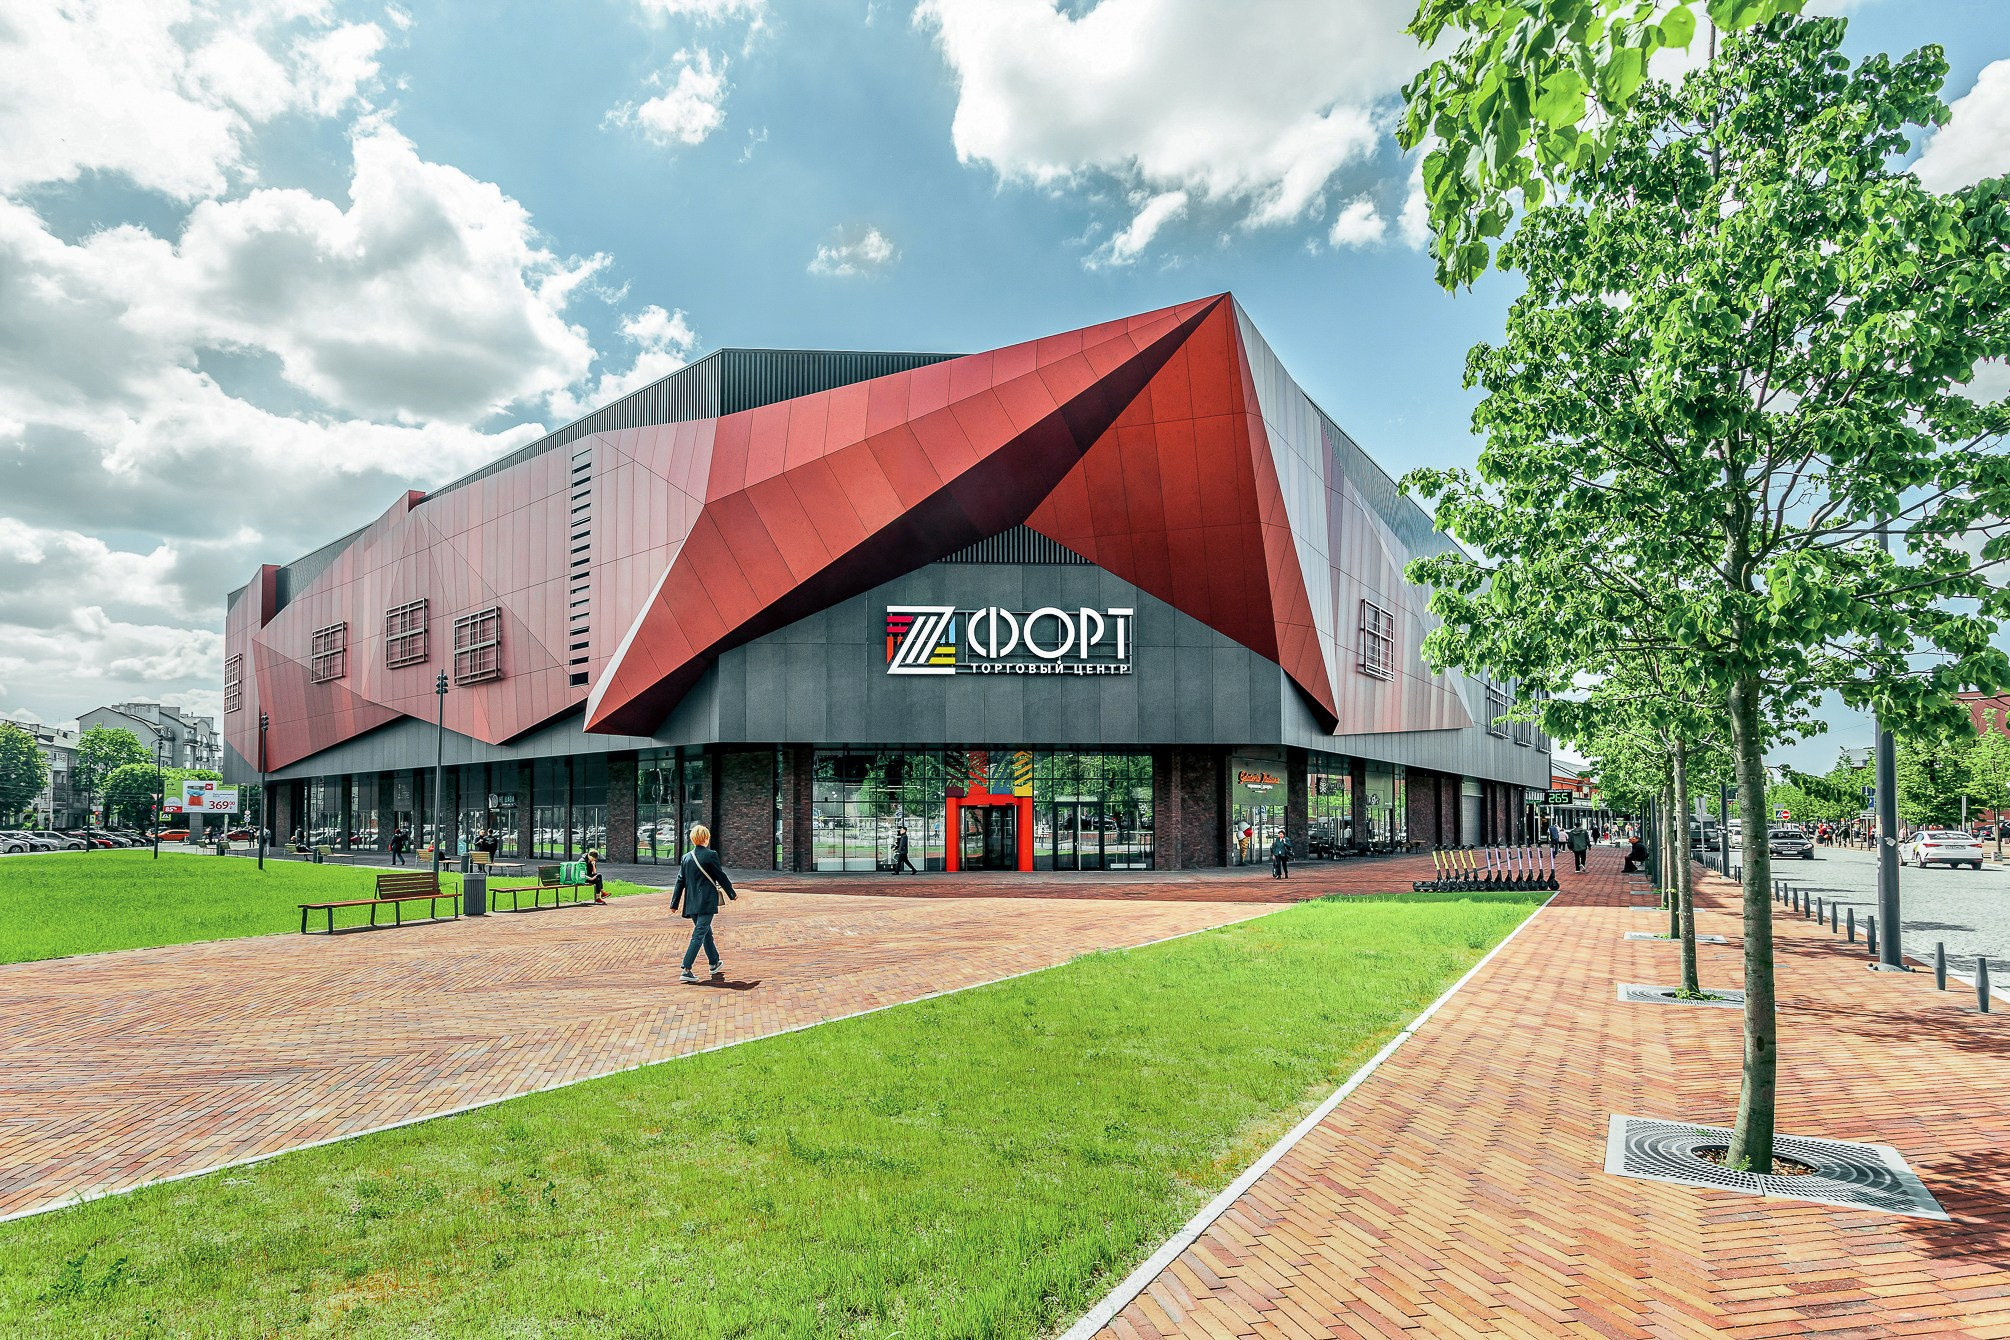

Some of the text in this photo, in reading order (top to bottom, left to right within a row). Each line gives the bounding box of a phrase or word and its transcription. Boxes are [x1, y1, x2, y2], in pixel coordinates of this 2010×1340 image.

[967, 606, 1134, 659] ФОРТ
[970, 660, 1128, 676] ТОРГОВЫЙ ЦЕНТР
[1548, 792, 1569, 803] 265
[208, 800, 229, 810] 369
